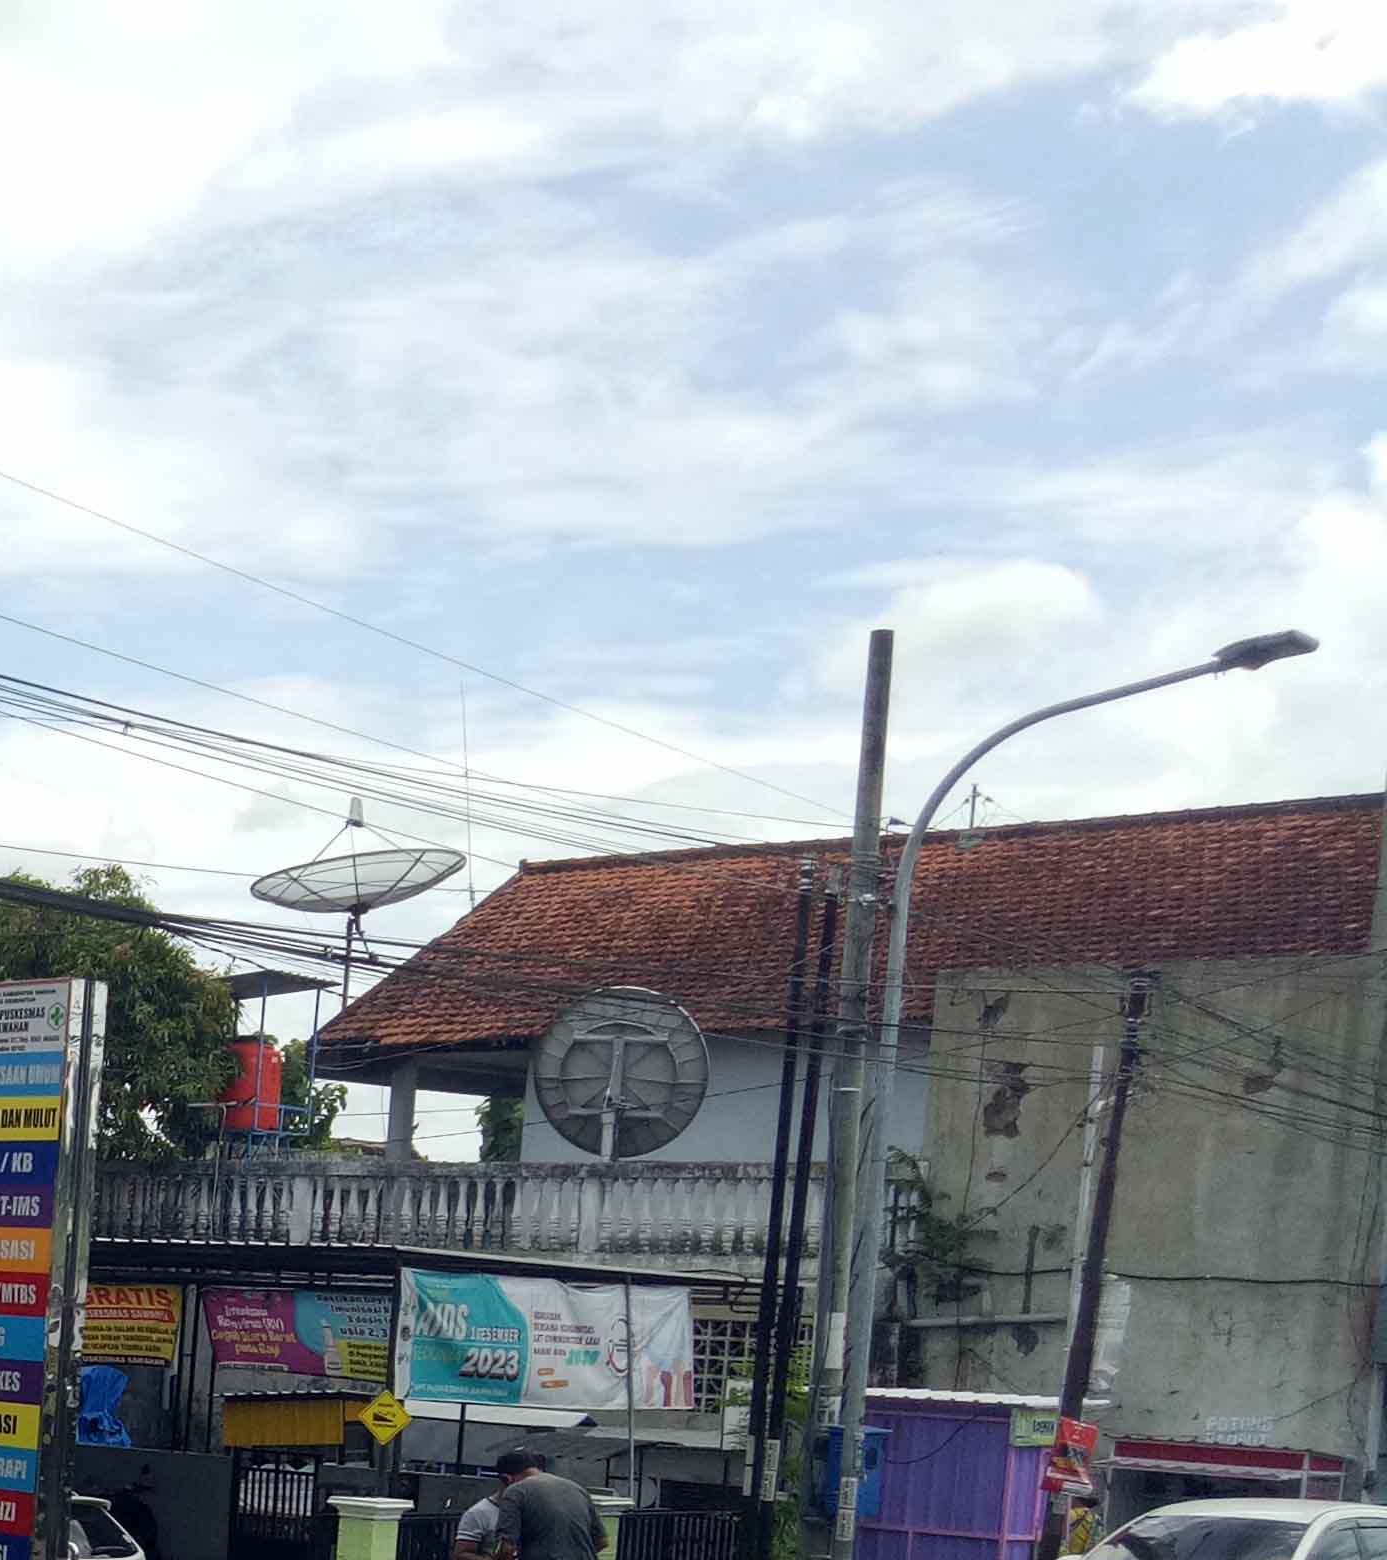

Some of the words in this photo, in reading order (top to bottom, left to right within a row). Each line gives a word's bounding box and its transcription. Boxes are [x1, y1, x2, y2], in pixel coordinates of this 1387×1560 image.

[0, 1007, 45, 1020] PUSKESMAS
[0, 1108, 22, 1129] DAN
[23, 1107, 58, 1129] MULUT
[0, 1151, 10, 1173] /
[11, 1152, 33, 1173] KB
[459, 1347, 520, 1382] 2023
